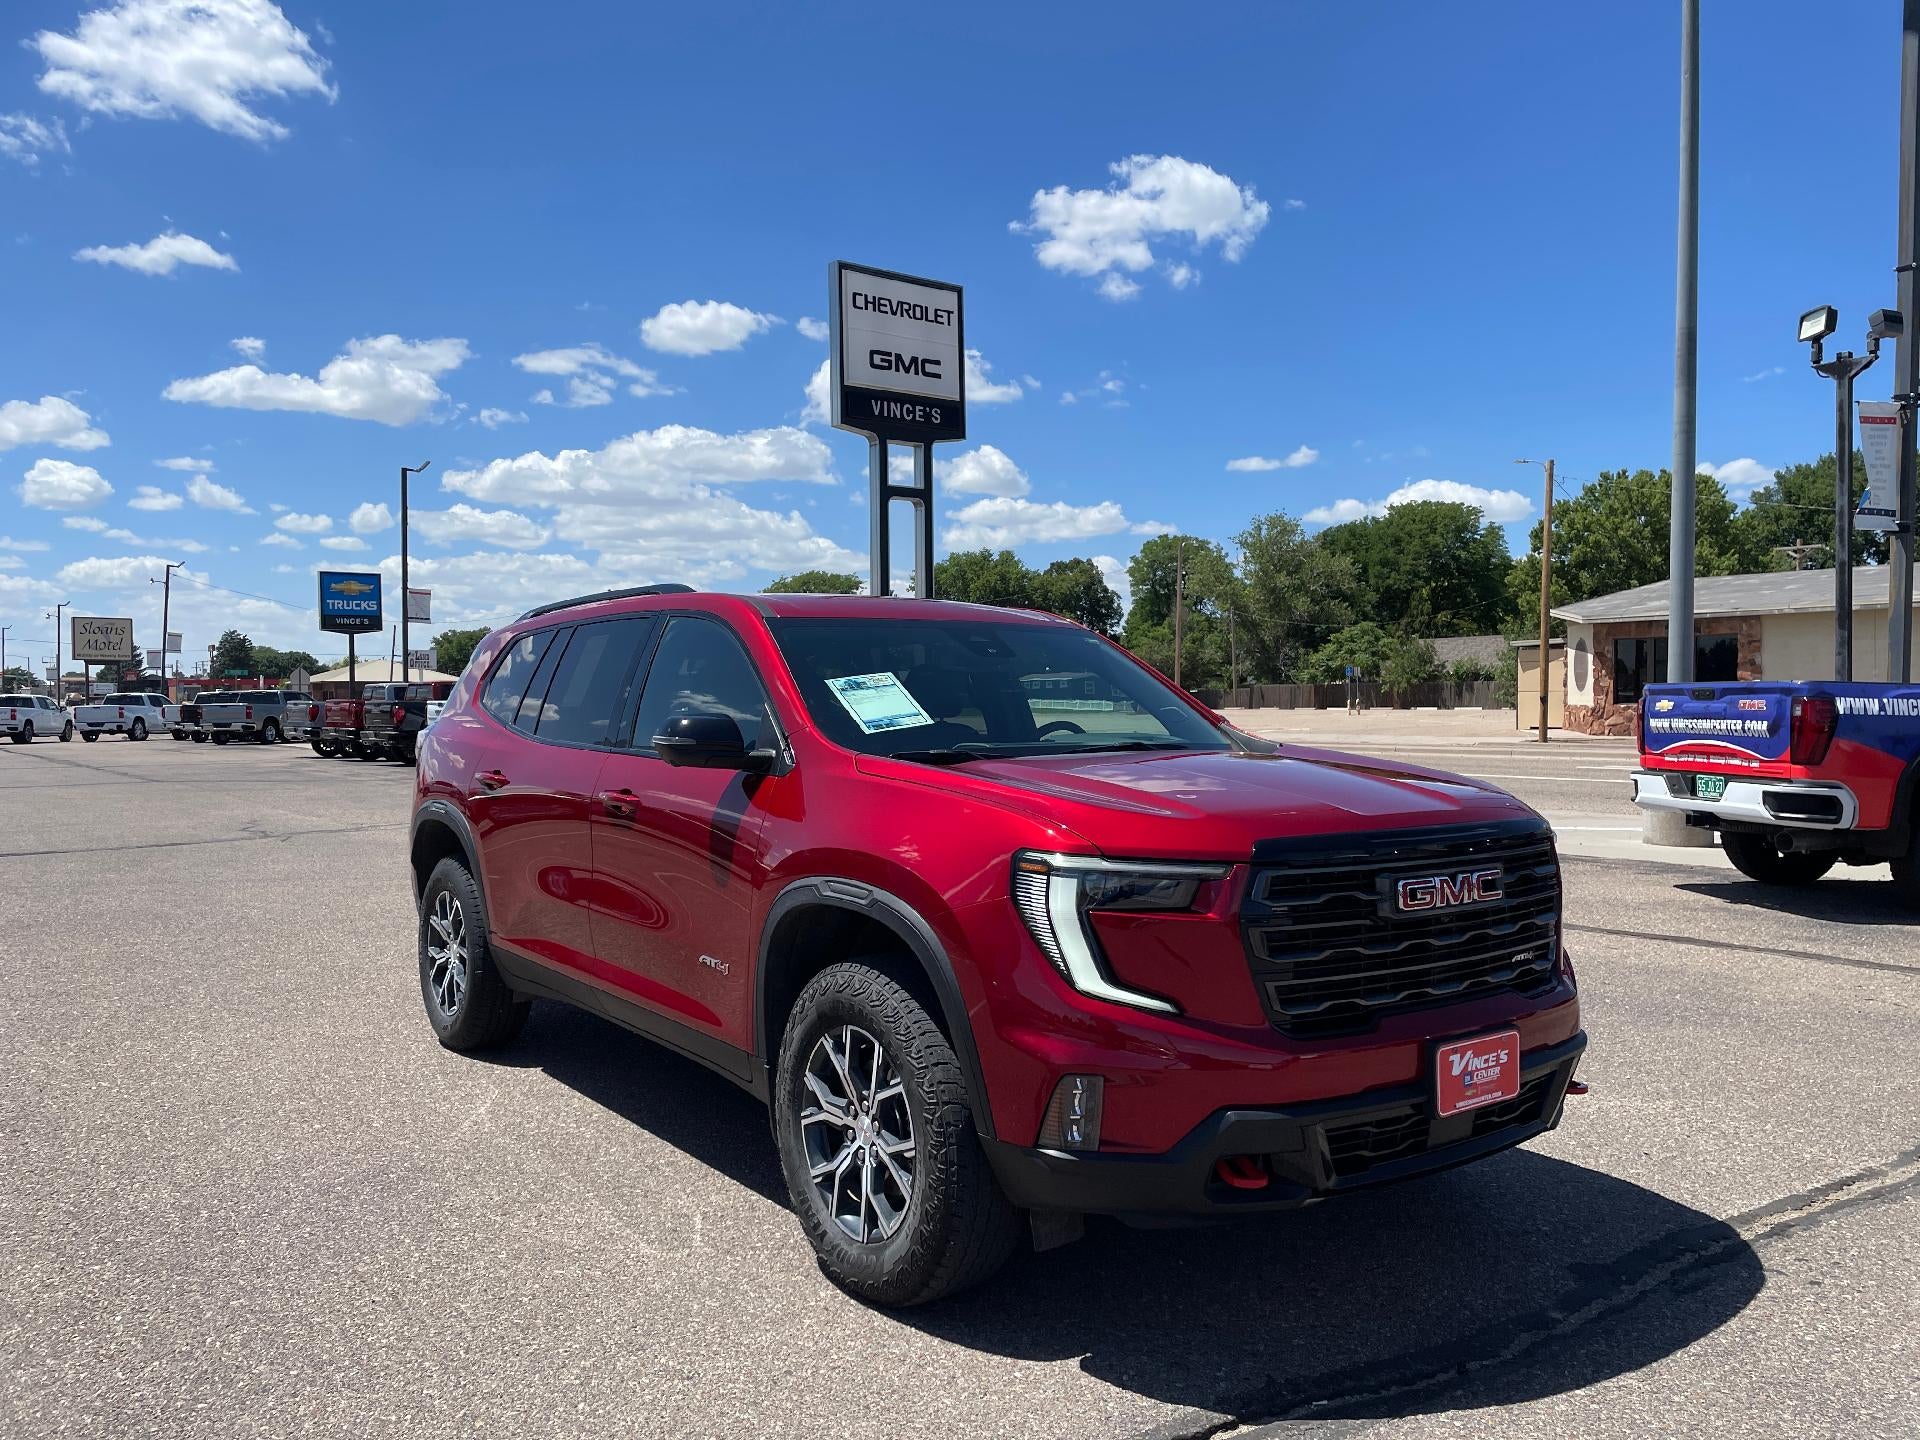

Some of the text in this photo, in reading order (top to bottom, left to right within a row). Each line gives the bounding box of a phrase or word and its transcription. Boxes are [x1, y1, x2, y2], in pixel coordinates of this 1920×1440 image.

[852, 291, 954, 327] CHEVROLET
[869, 349, 942, 379] GMC
[871, 399, 941, 424] VINCE'S
[326, 600, 378, 611] TRUCKS
[79, 621, 126, 636] Sloans
[335, 617, 369, 625] VINCE'S
[81, 638, 123, 651] Motel
[1737, 699, 1766, 711] GMC
[1397, 869, 1502, 911] GMC
[698, 955, 730, 976] AT4
[1448, 1049, 1509, 1077] VINCE'S
[1473, 1066, 1501, 1081] CENTER
